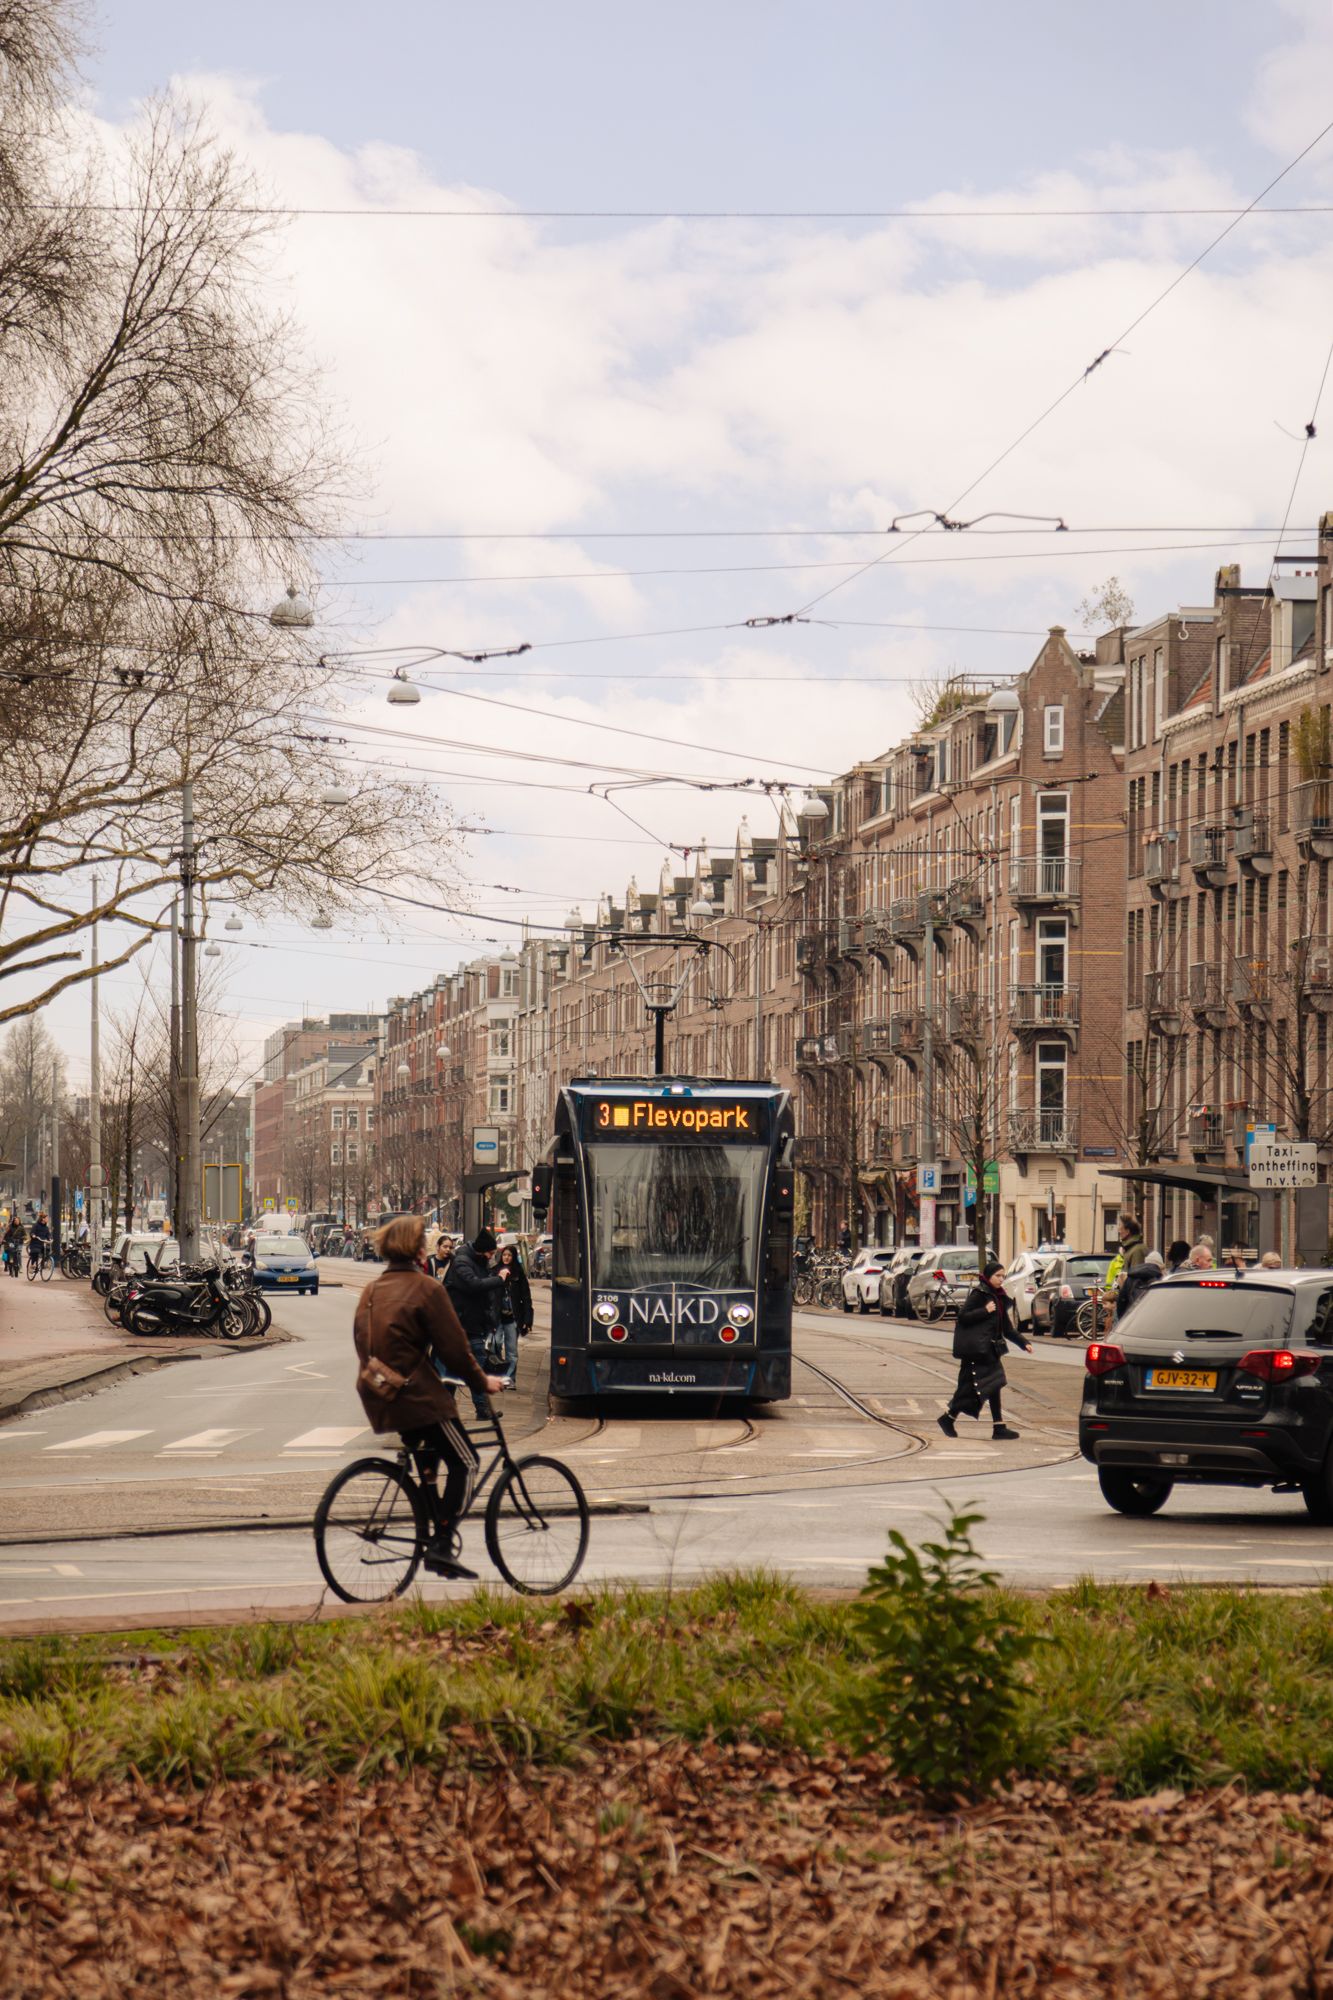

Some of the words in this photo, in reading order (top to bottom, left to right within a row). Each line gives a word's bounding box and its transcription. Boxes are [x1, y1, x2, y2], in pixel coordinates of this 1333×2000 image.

[599, 1103, 610, 1127] 3
[633, 1102, 749, 1132] Flevopark
[1266, 1145, 1300, 1157] Taxi-
[1251, 1160, 1316, 1174] ontheffing
[1266, 1175, 1301, 1186] n.v.t.
[629, 1297, 719, 1324] NA-KD
[648, 1372, 696, 1383] na-kd.com
[1156, 1371, 1210, 1386] GJV-32-K
